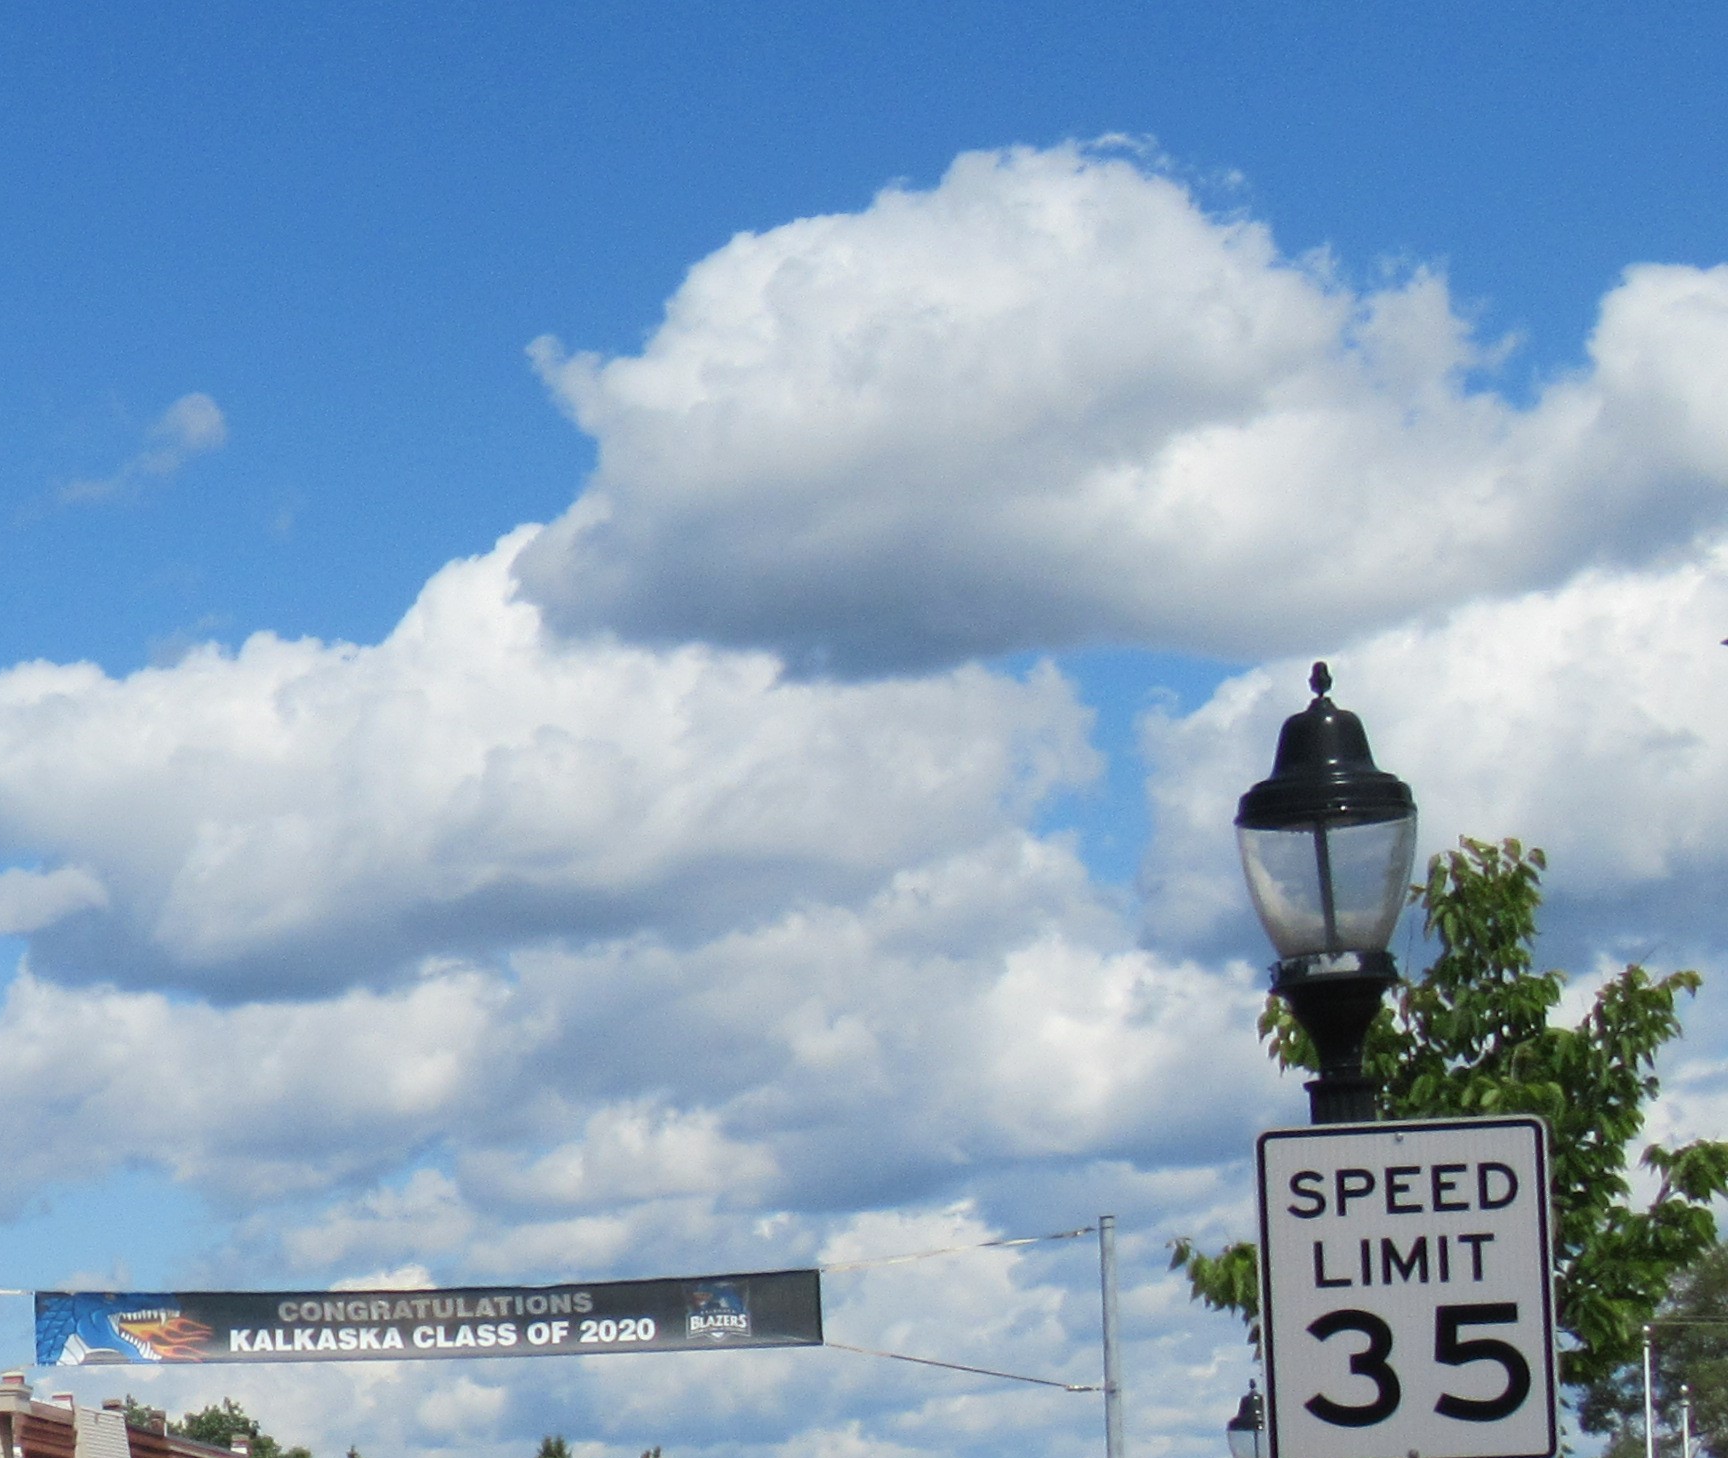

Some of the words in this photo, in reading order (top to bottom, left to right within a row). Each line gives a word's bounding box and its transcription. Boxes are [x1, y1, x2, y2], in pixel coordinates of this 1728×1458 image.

[1287, 1162, 1519, 1219] SPEED
[1313, 1233, 1495, 1288] LIMIT
[278, 1292, 594, 1322] CONGRATULATIONS
[689, 1314, 747, 1331] BLAZERS
[230, 1327, 405, 1352] KALKASKA
[413, 1324, 518, 1349] CLASS
[526, 1321, 569, 1346] OF
[579, 1317, 656, 1344] 2020
[1304, 1302, 1531, 1428] 35
